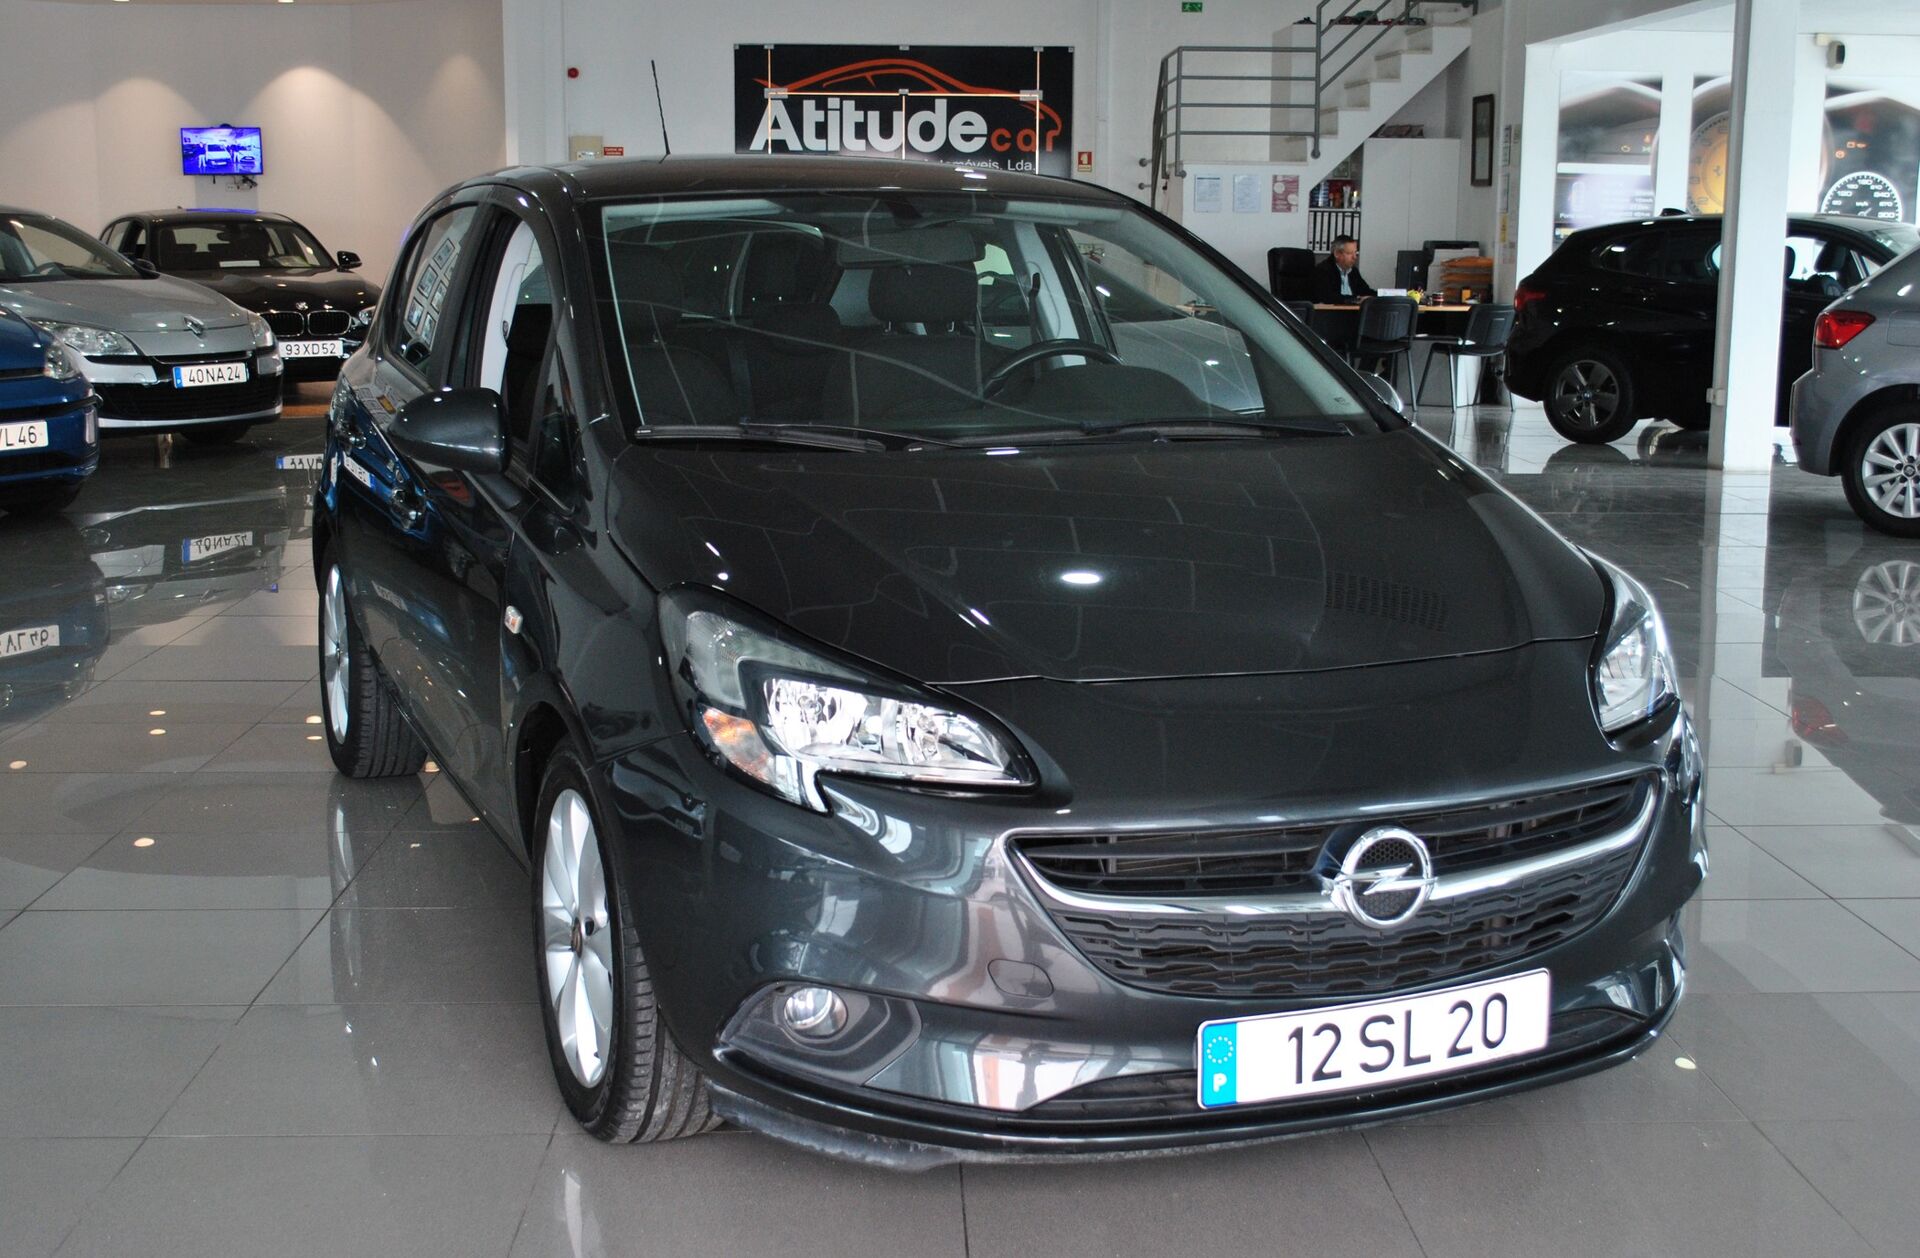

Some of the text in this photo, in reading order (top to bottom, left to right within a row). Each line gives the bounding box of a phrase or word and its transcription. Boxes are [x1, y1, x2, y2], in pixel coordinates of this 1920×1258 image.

[750, 98, 1062, 153] Atitude car
[1212, 1073, 1227, 1092] P
